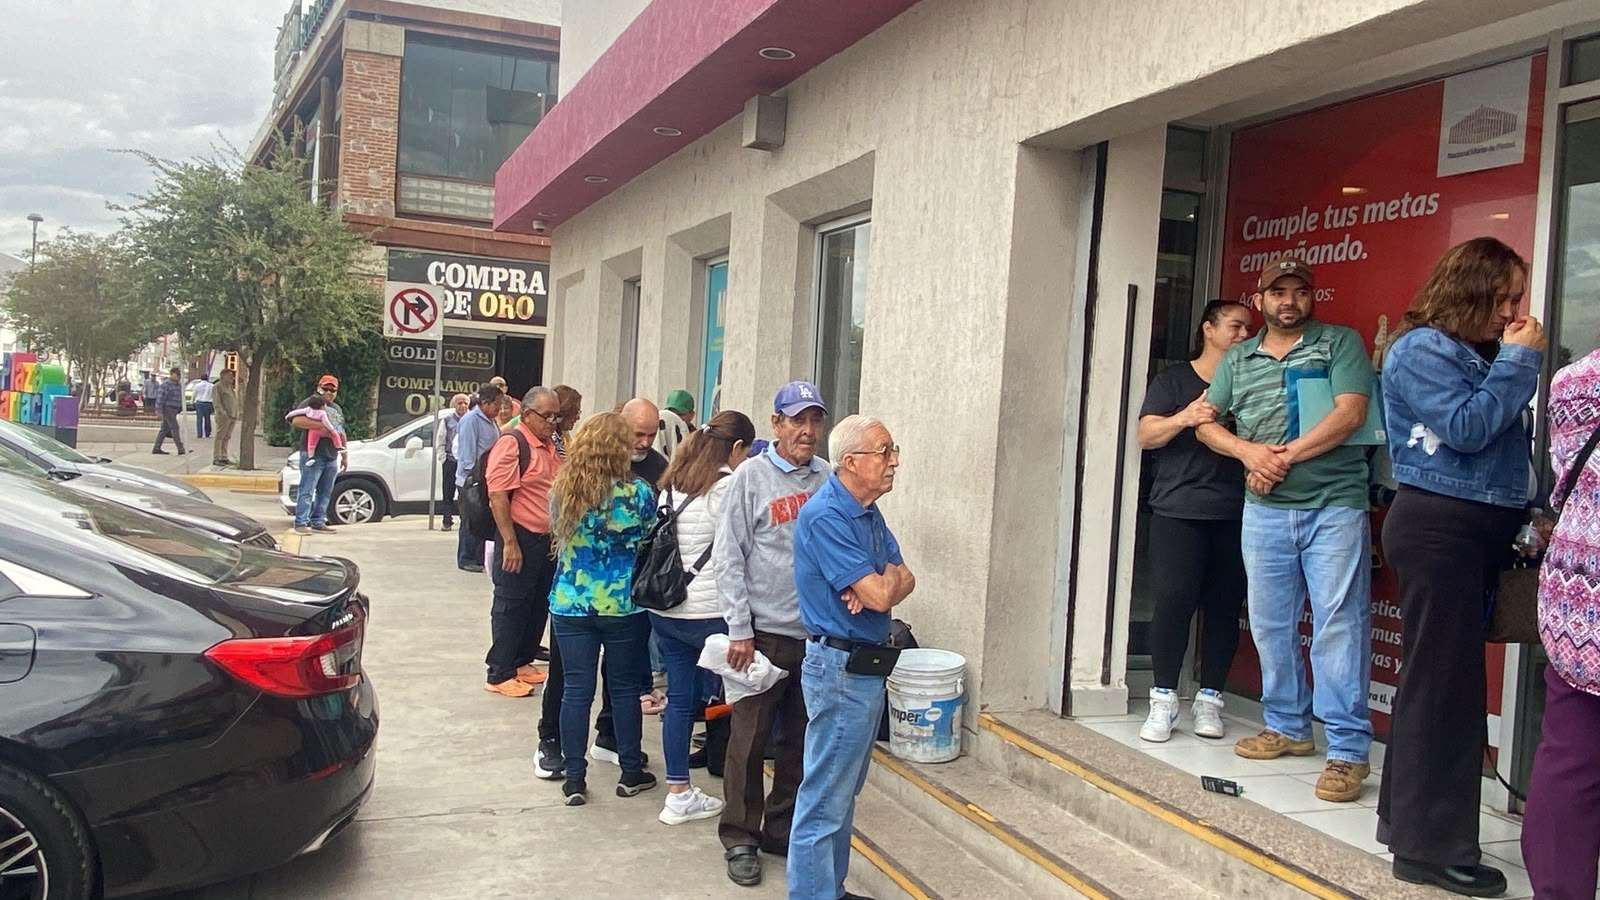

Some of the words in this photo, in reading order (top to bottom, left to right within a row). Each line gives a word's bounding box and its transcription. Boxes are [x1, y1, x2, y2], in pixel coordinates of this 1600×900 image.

[1242, 206, 1318, 241] Cumple
[1324, 204, 1358, 230] tus
[1362, 191, 1440, 224] metas
[427, 260, 547, 295] COMPRA
[479, 292, 535, 320] ORO
[390, 345, 438, 361] GOLD
[444, 350, 490, 365] CASH
[798, 384, 814, 399] LA
[890, 705, 922, 723] mper
